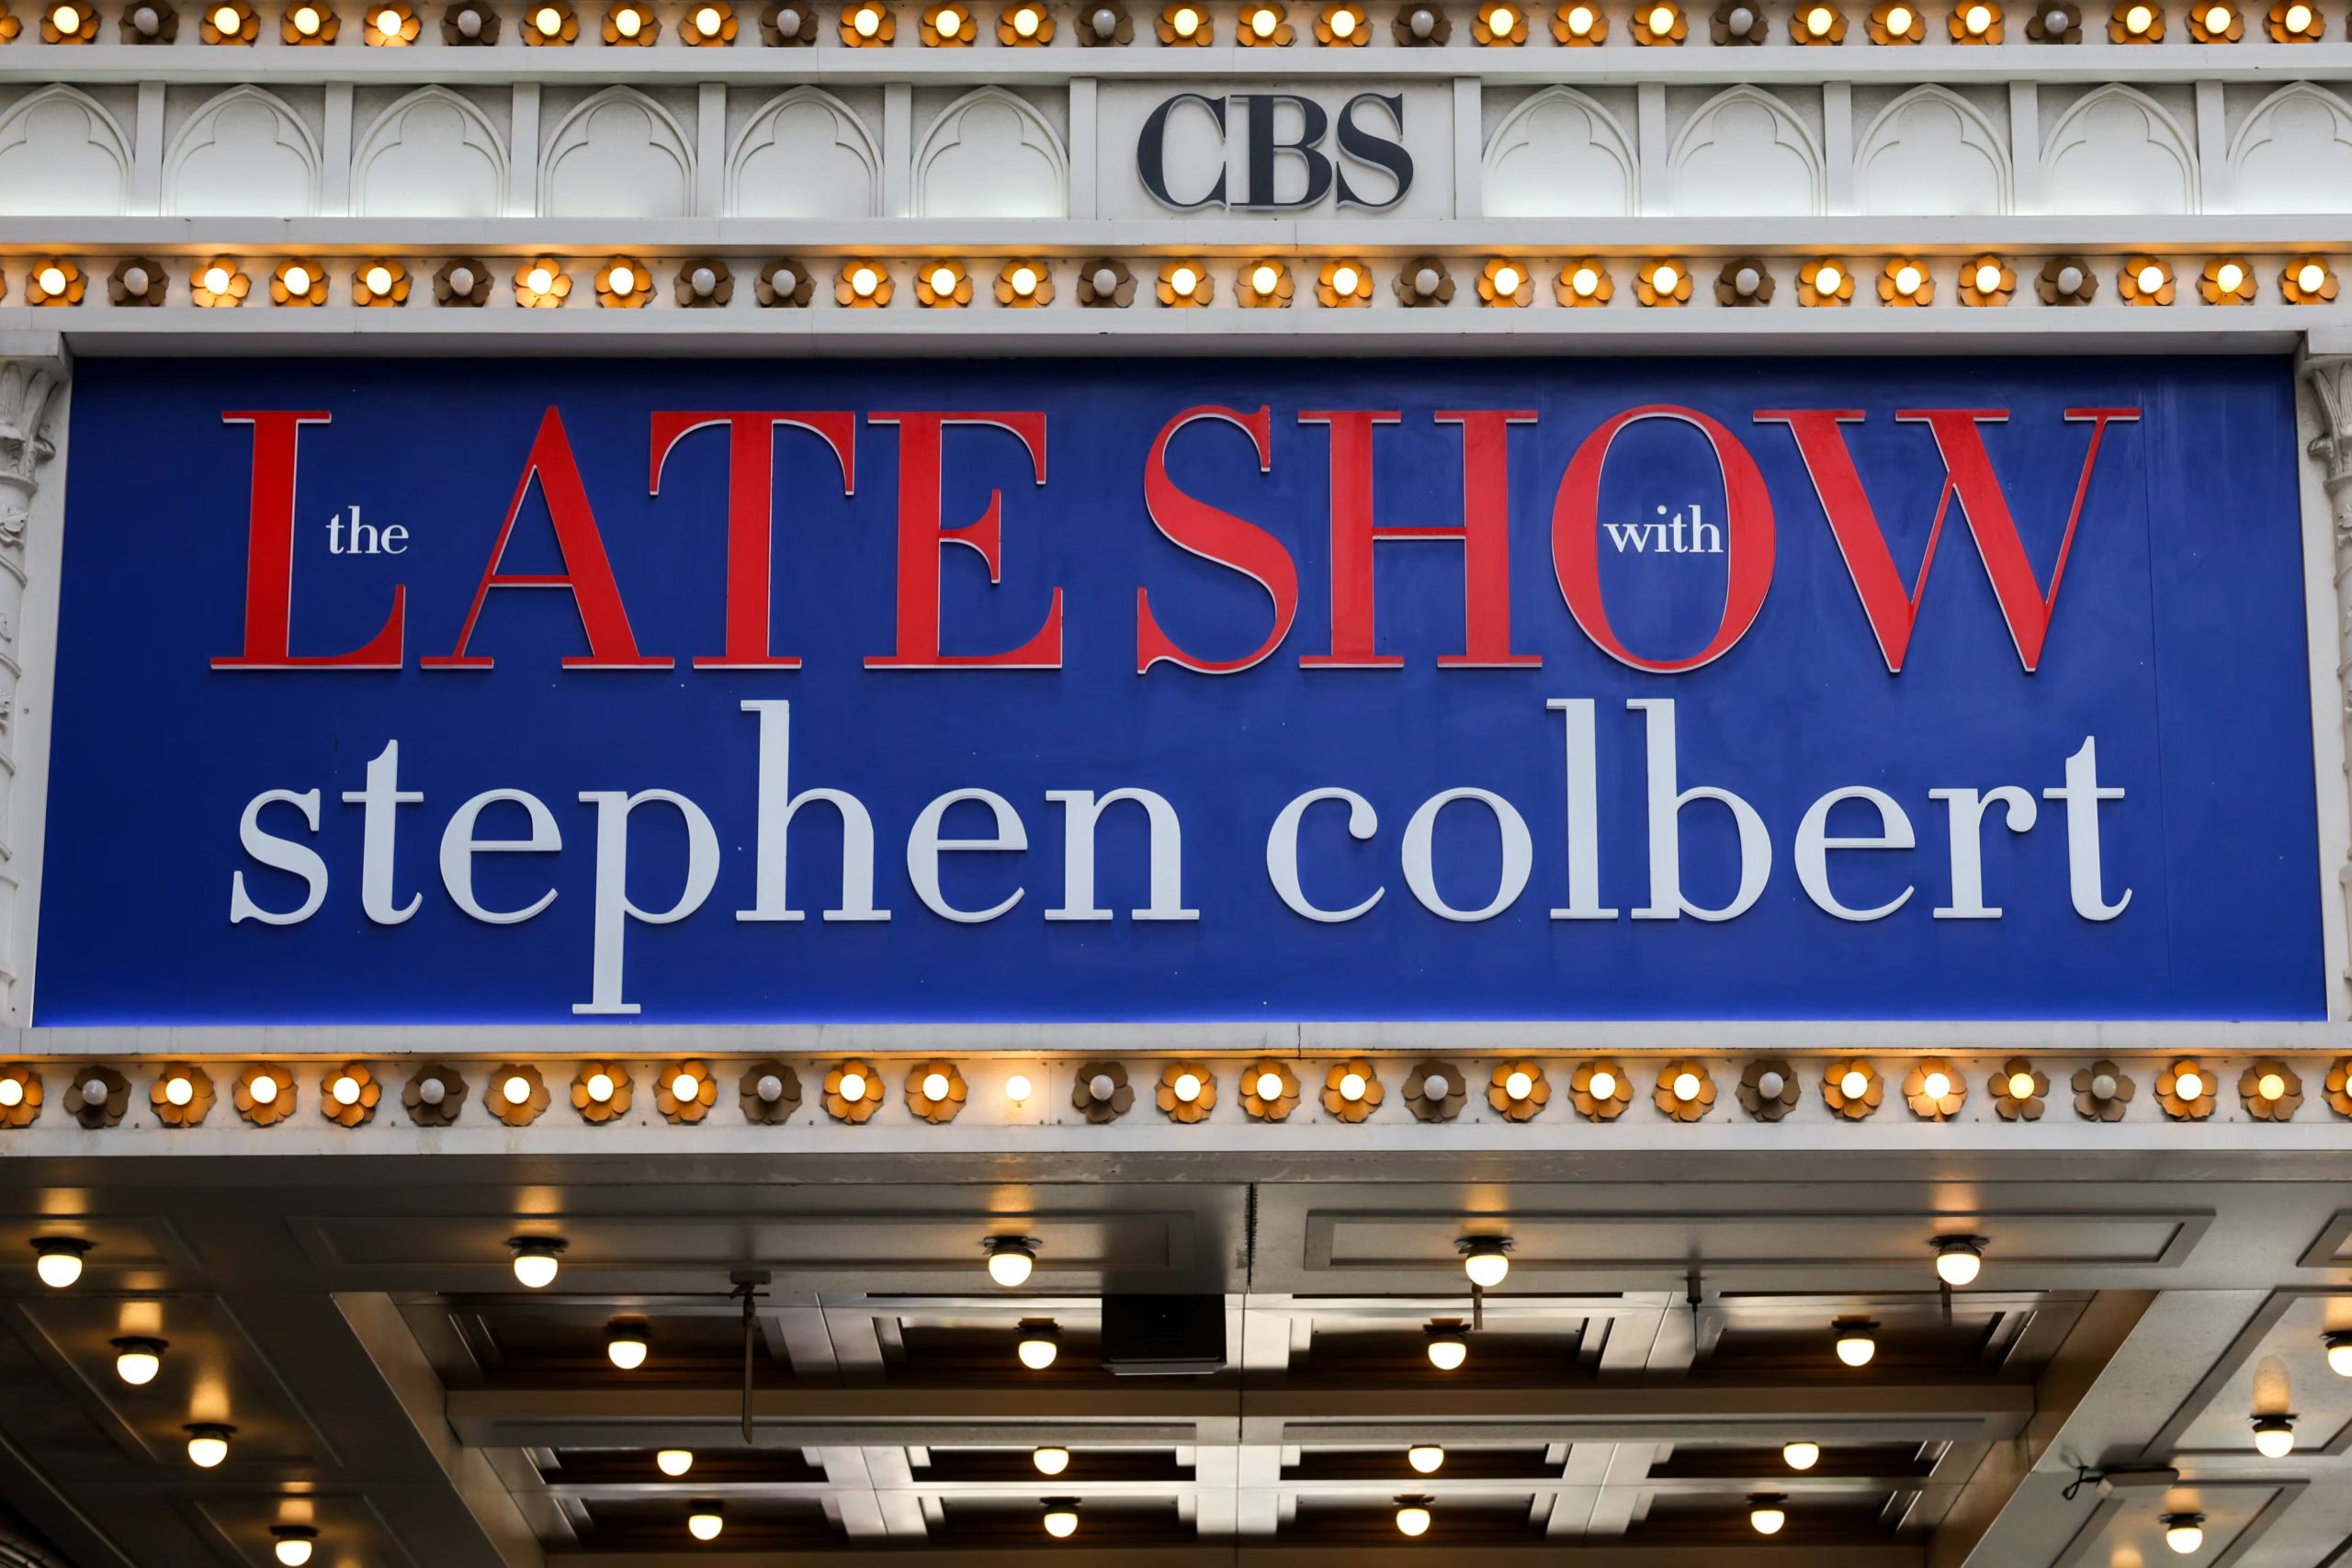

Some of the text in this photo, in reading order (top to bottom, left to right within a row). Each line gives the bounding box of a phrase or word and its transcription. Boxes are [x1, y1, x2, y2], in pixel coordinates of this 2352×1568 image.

[1136, 93, 1414, 212] CBS
[210, 403, 2141, 675] LATE SHOW
[325, 505, 410, 555] the
[1602, 502, 1724, 555] with
[229, 698, 2132, 1018] stephen colbert
